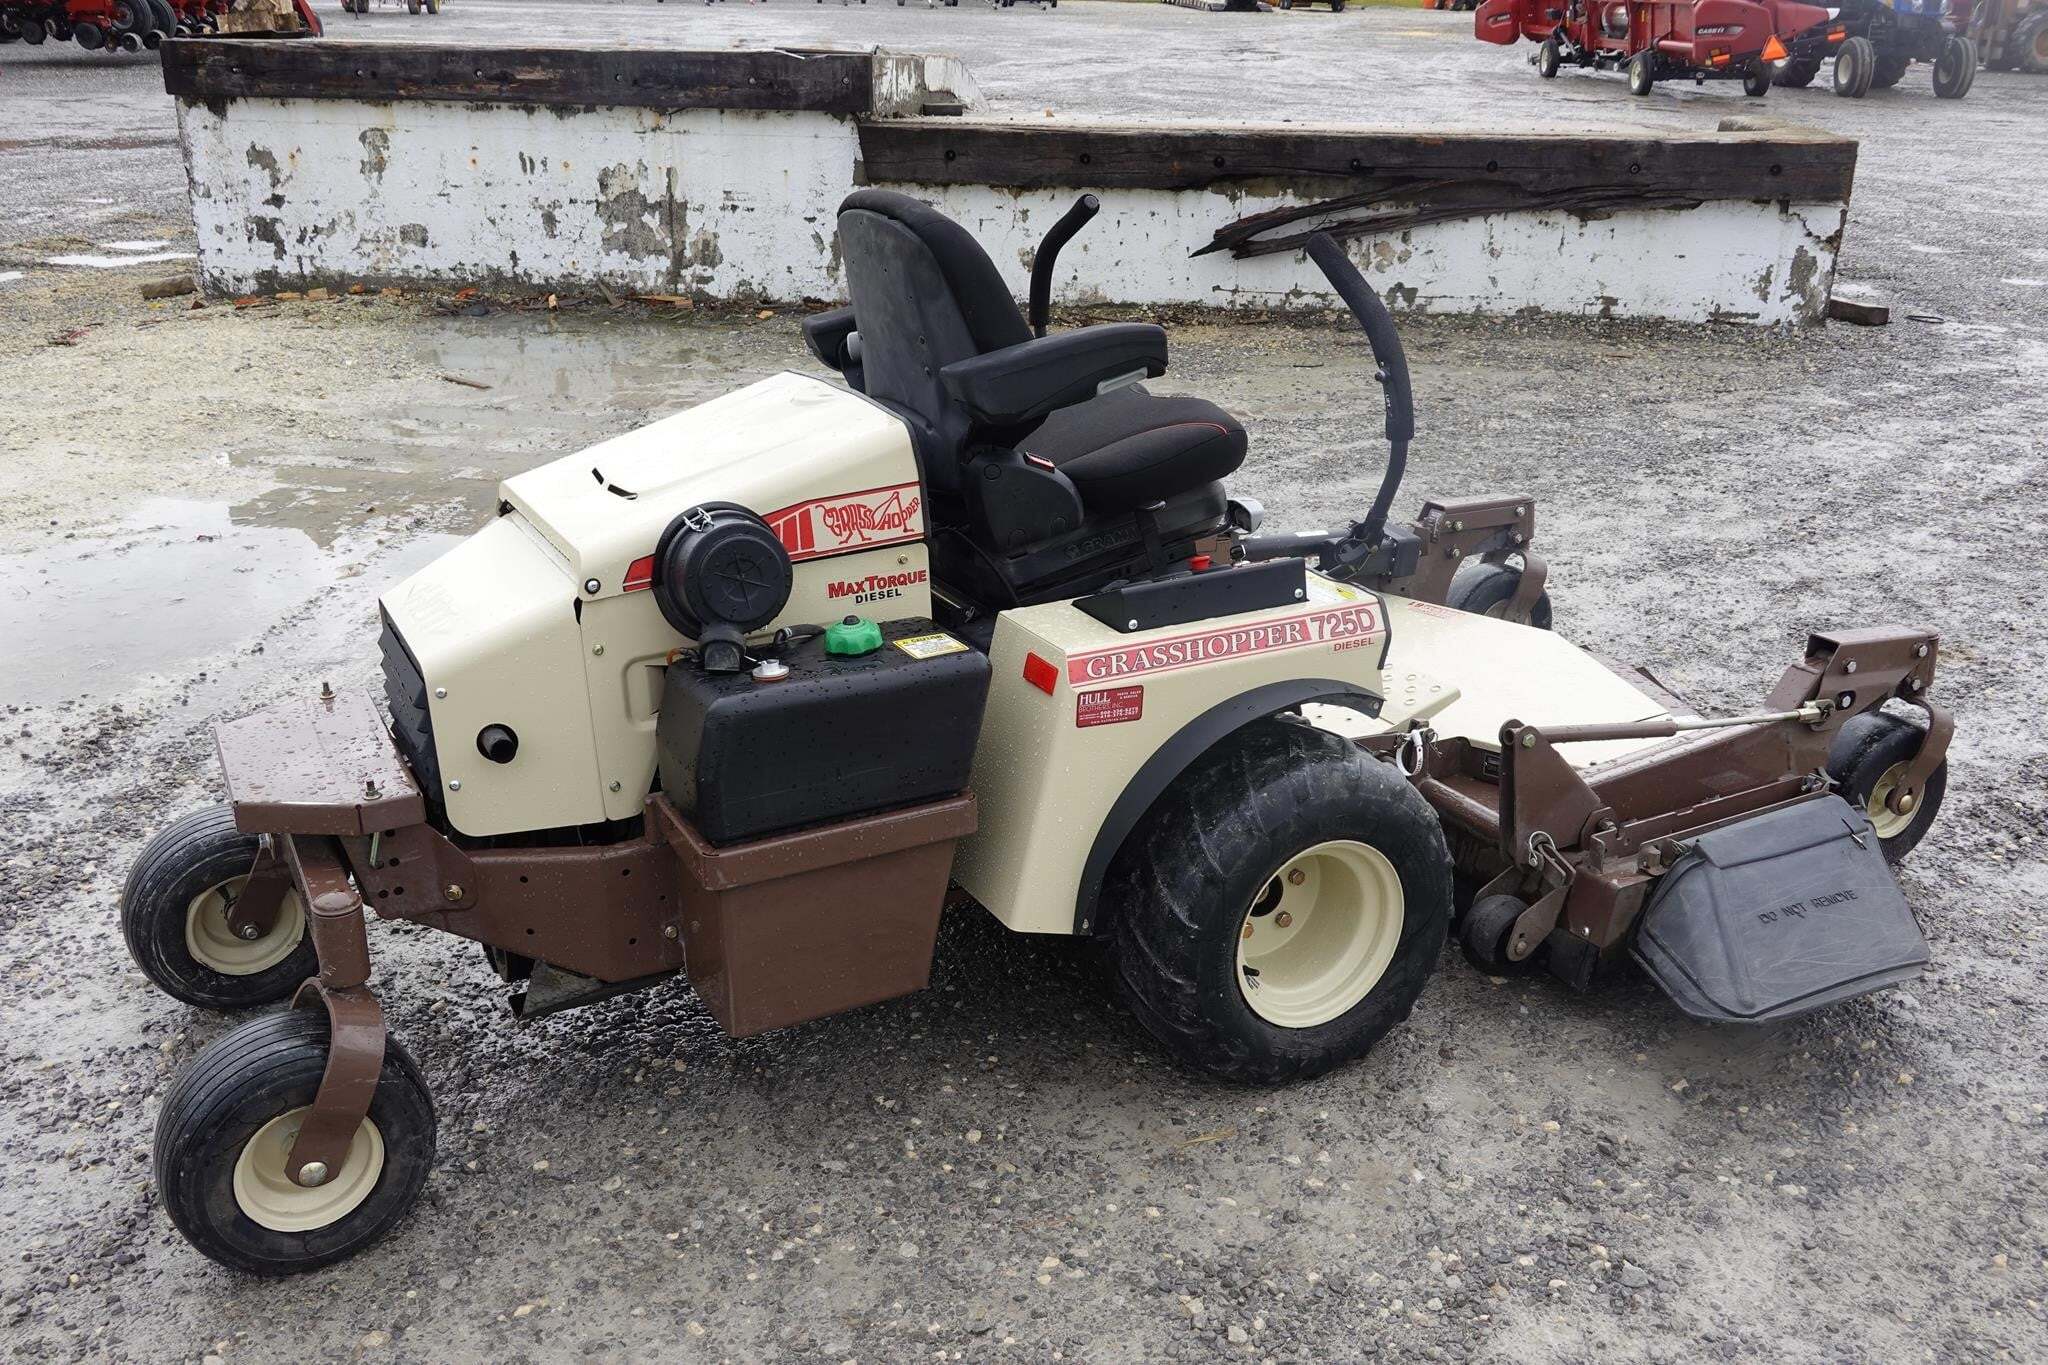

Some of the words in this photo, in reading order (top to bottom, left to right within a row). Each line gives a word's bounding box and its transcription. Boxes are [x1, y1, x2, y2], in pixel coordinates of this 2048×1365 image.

[855, 588, 903, 604] DIESEL
[1310, 608, 1375, 640] 725D
[1086, 622, 1303, 678] GRASSHOPPER
[1333, 638, 1374, 652] DIESEL
[1079, 692, 1111, 705] HULL
[1758, 911, 1778, 924] DO
[1781, 902, 1807, 918] NOT
[1810, 890, 1858, 908] REMOVE
